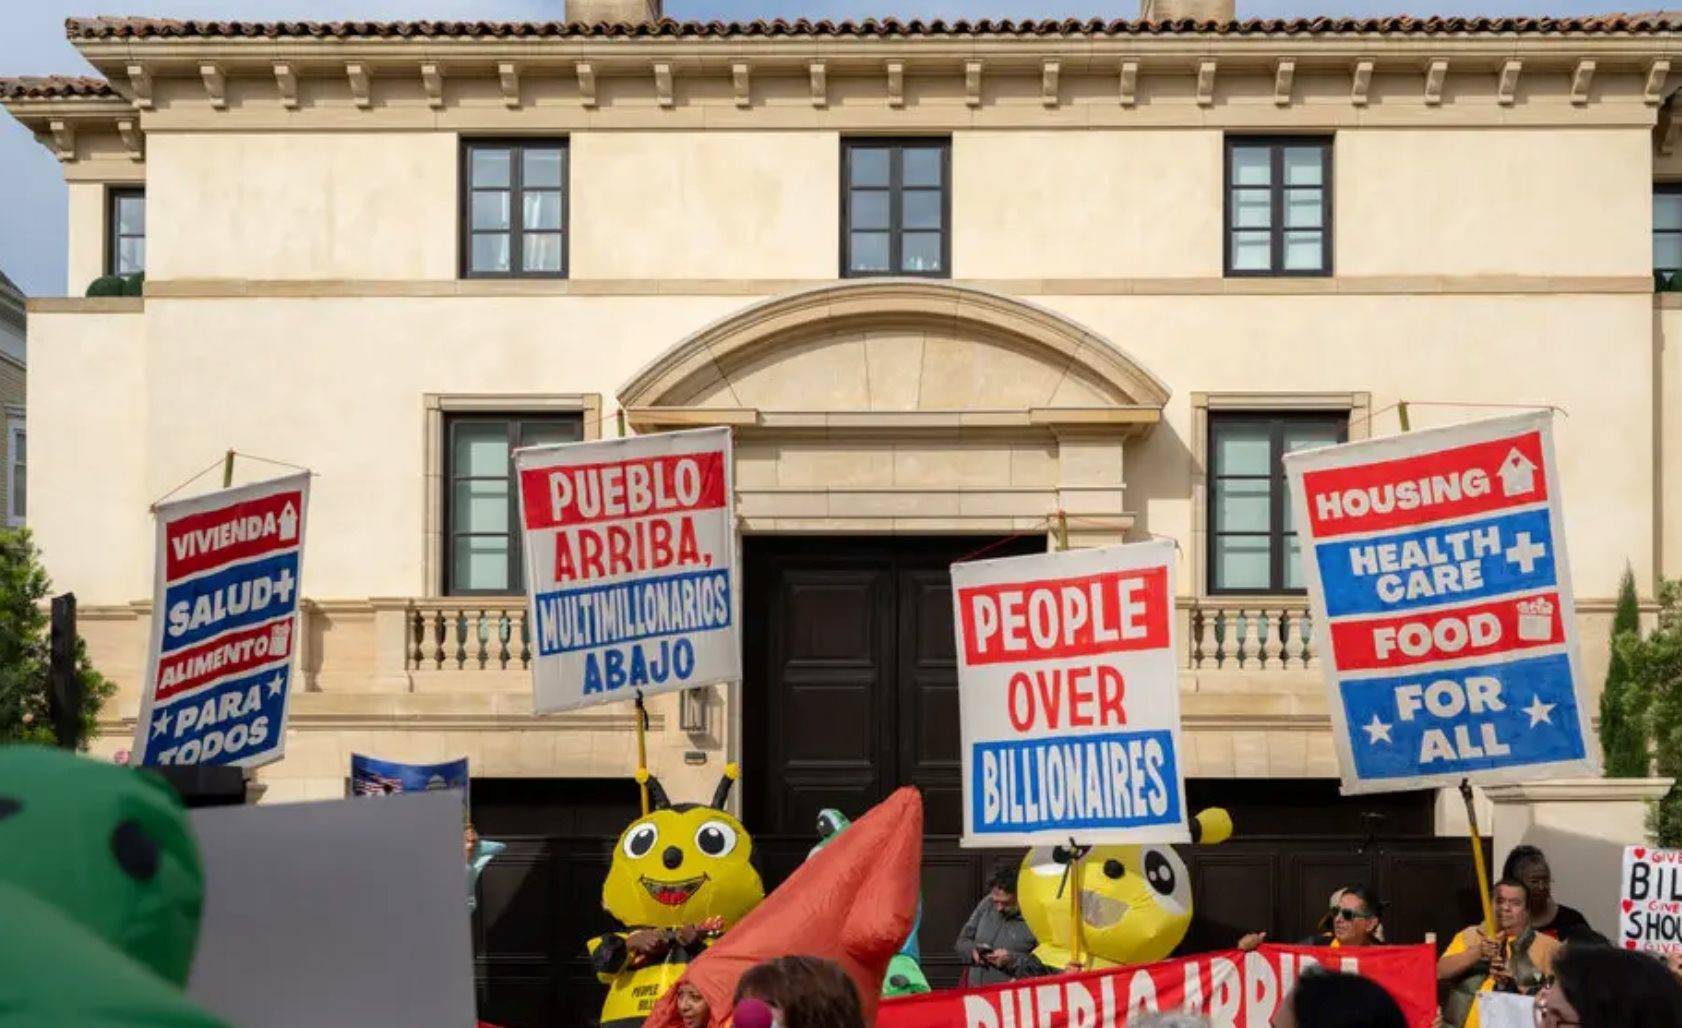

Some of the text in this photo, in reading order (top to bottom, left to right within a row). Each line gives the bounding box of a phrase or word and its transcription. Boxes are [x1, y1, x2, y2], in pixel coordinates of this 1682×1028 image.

[549, 458, 701, 521] PUEBLO
[1316, 468, 1491, 521] HOUSING
[172, 511, 277, 561] VIVIENDA
[554, 516, 712, 582] ARRIBA,
[1349, 525, 1502, 577] HEALTH
[168, 576, 273, 637] SALUD
[1375, 559, 1484, 603] CARE
[538, 574, 729, 651] MULTIMILLONARIOS
[972, 577, 1148, 653] PEOPLE
[1373, 612, 1502, 660] FOOD
[158, 637, 267, 690] ALIMENTO
[583, 637, 695, 695] ABAJO
[173, 683, 262, 738] PARA
[1008, 665, 1127, 732] OVER
[1394, 676, 1506, 721] FOR
[157, 716, 269, 765] TODOS
[1419, 722, 1510, 764] ALL
[982, 738, 1168, 824] BILLIONAIRES
